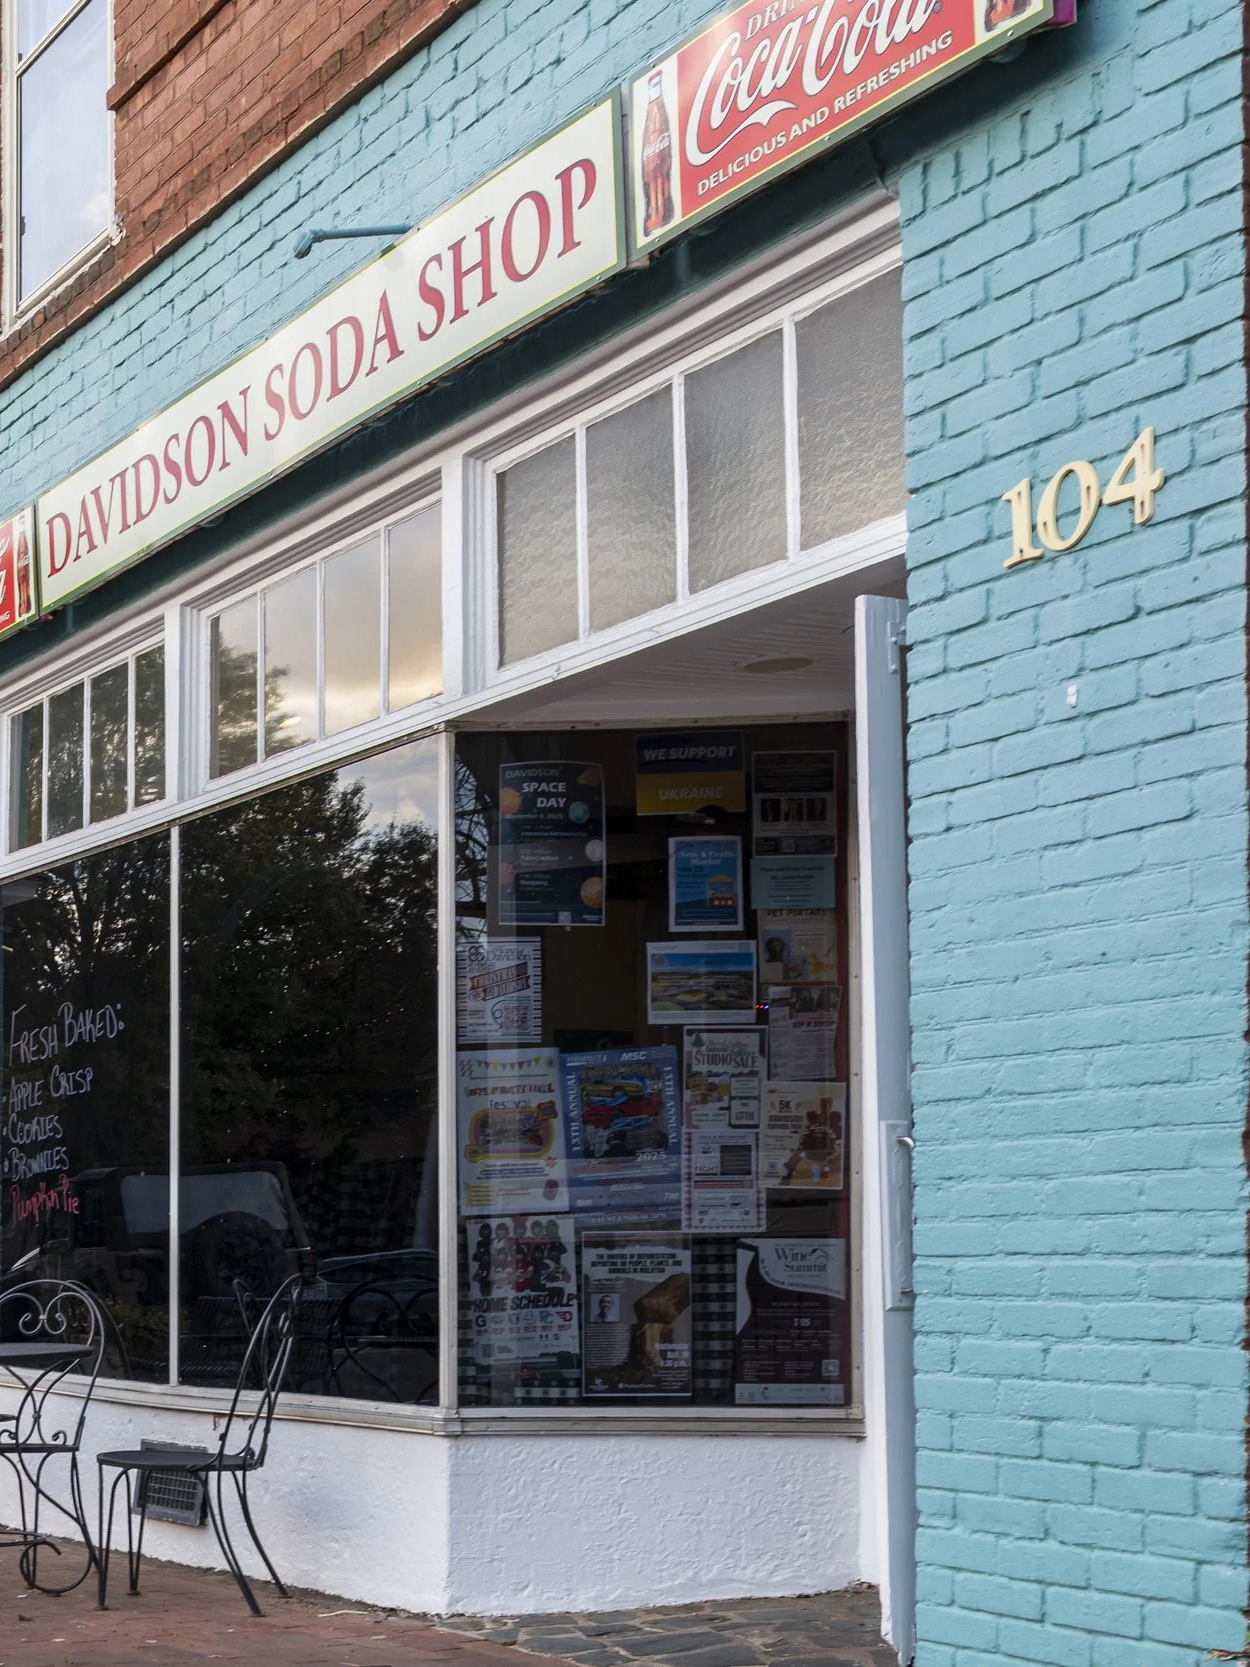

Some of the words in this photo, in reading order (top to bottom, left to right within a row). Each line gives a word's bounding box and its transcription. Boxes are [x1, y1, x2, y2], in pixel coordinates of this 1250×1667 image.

[744, 0, 798, 41] DRI
[697, 132, 787, 197] DELICIOUS
[789, 105, 829, 141] AND
[834, 30, 953, 115] REFRESHING
[46, 386, 250, 579] DAVIDSON
[264, 290, 404, 440] SODA
[417, 158, 598, 342] SHOP
[1001, 425, 1165, 568] 104
[643, 748, 667, 761] WE
[669, 745, 737, 760] SUPPORT
[505, 767, 560, 779] DAVIDSON
[521, 782, 567, 793] SPACE
[658, 786, 724, 801] UKRAINE
[536, 797, 567, 808] DAY
[620, 1051, 647, 1062] MSC
[693, 1052, 732, 1067] STUDIO
[733, 1055, 759, 1069] SALE
[9, 1077, 44, 1115] APPLE
[50, 1064, 94, 1099] CRISP
[564, 1070, 579, 1118] ANNUAL
[778, 1100, 792, 1110] 5K
[9, 1113, 63, 1144] COOKIES
[665, 1099, 679, 1144] ANNUAL
[8, 1146, 70, 1182] BROWNIES
[635, 1152, 667, 1162] 2025
[774, 1248, 811, 1262] Wine
[783, 1262, 828, 1273] Summit
[472, 1297, 508, 1314] HOME
[510, 1293, 575, 1310] SCHEDULE
